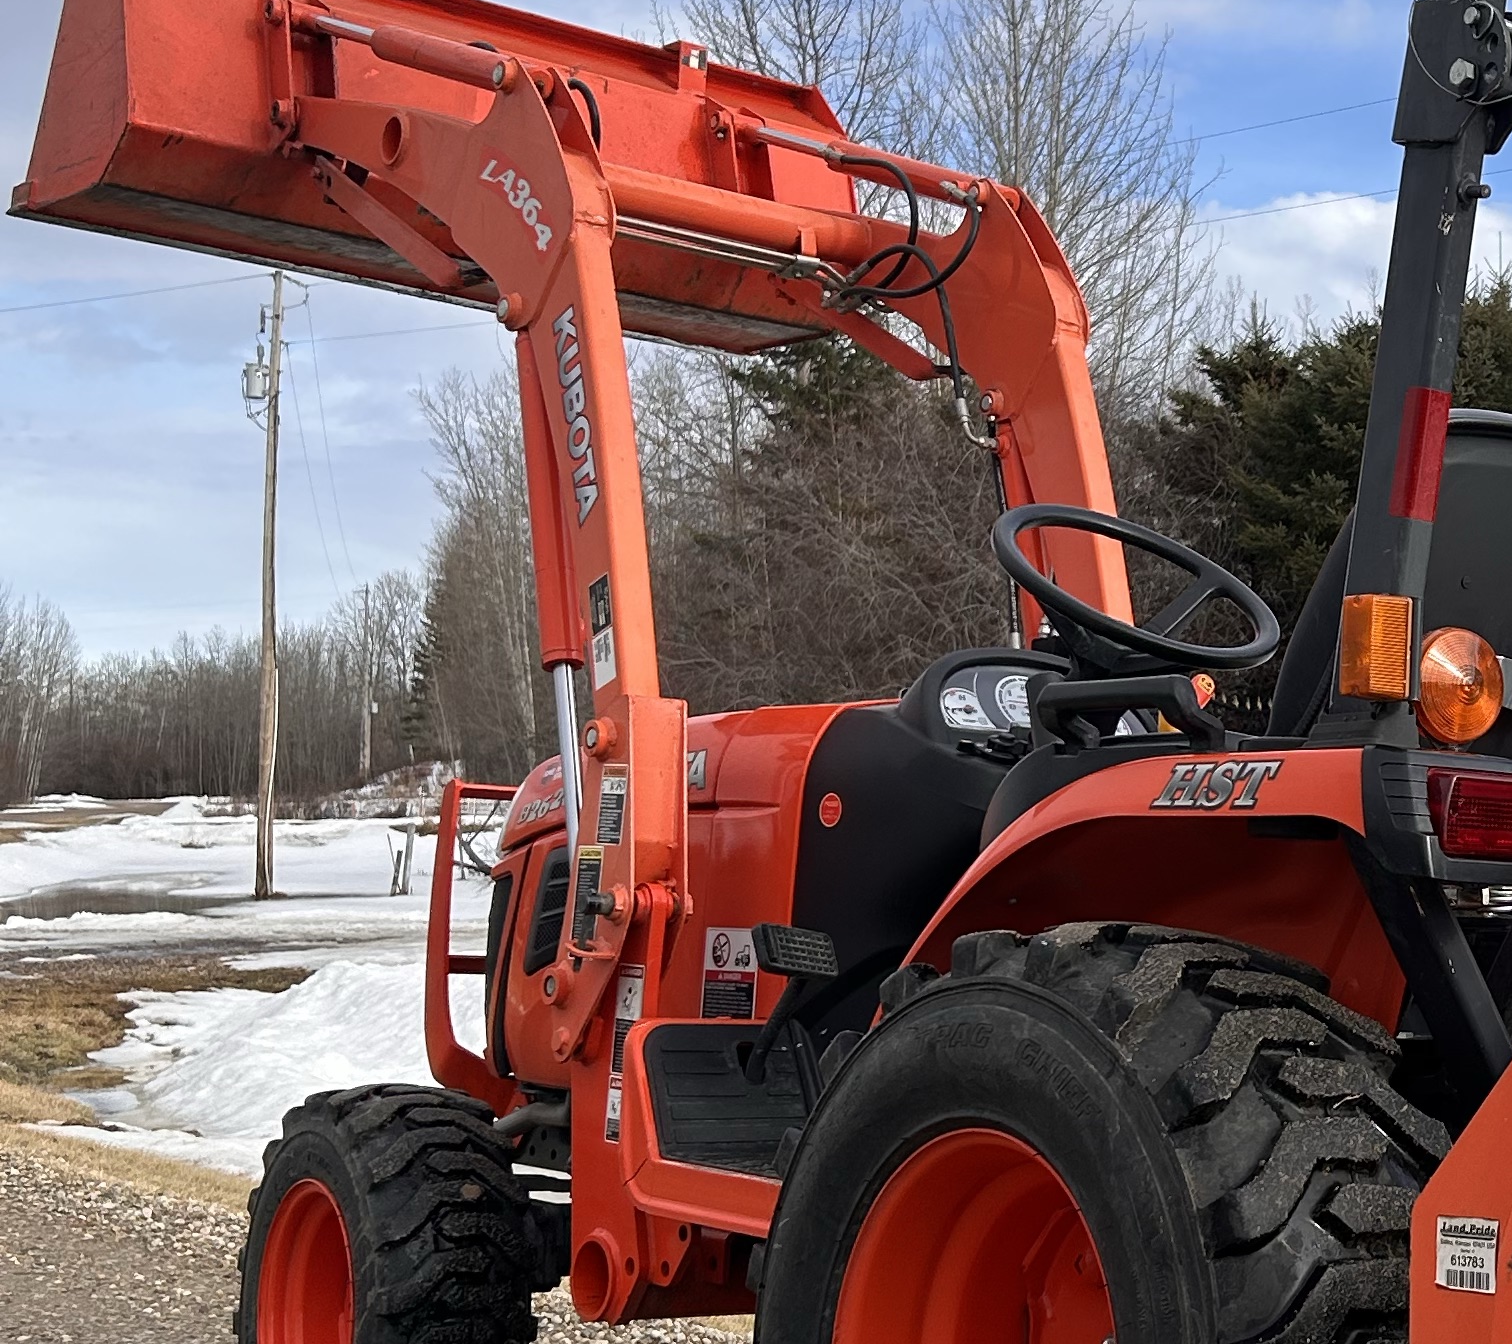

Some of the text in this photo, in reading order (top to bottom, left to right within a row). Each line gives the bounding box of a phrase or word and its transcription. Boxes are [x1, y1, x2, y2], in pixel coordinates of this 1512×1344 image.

[480, 159, 552, 252] LA364
[552, 304, 599, 528] KUBOTA
[517, 787, 566, 825] B262
[1149, 758, 1285, 811] HST
[1440, 1221, 1496, 1237] Land Pride
[1450, 1254, 1485, 1269] 613783
